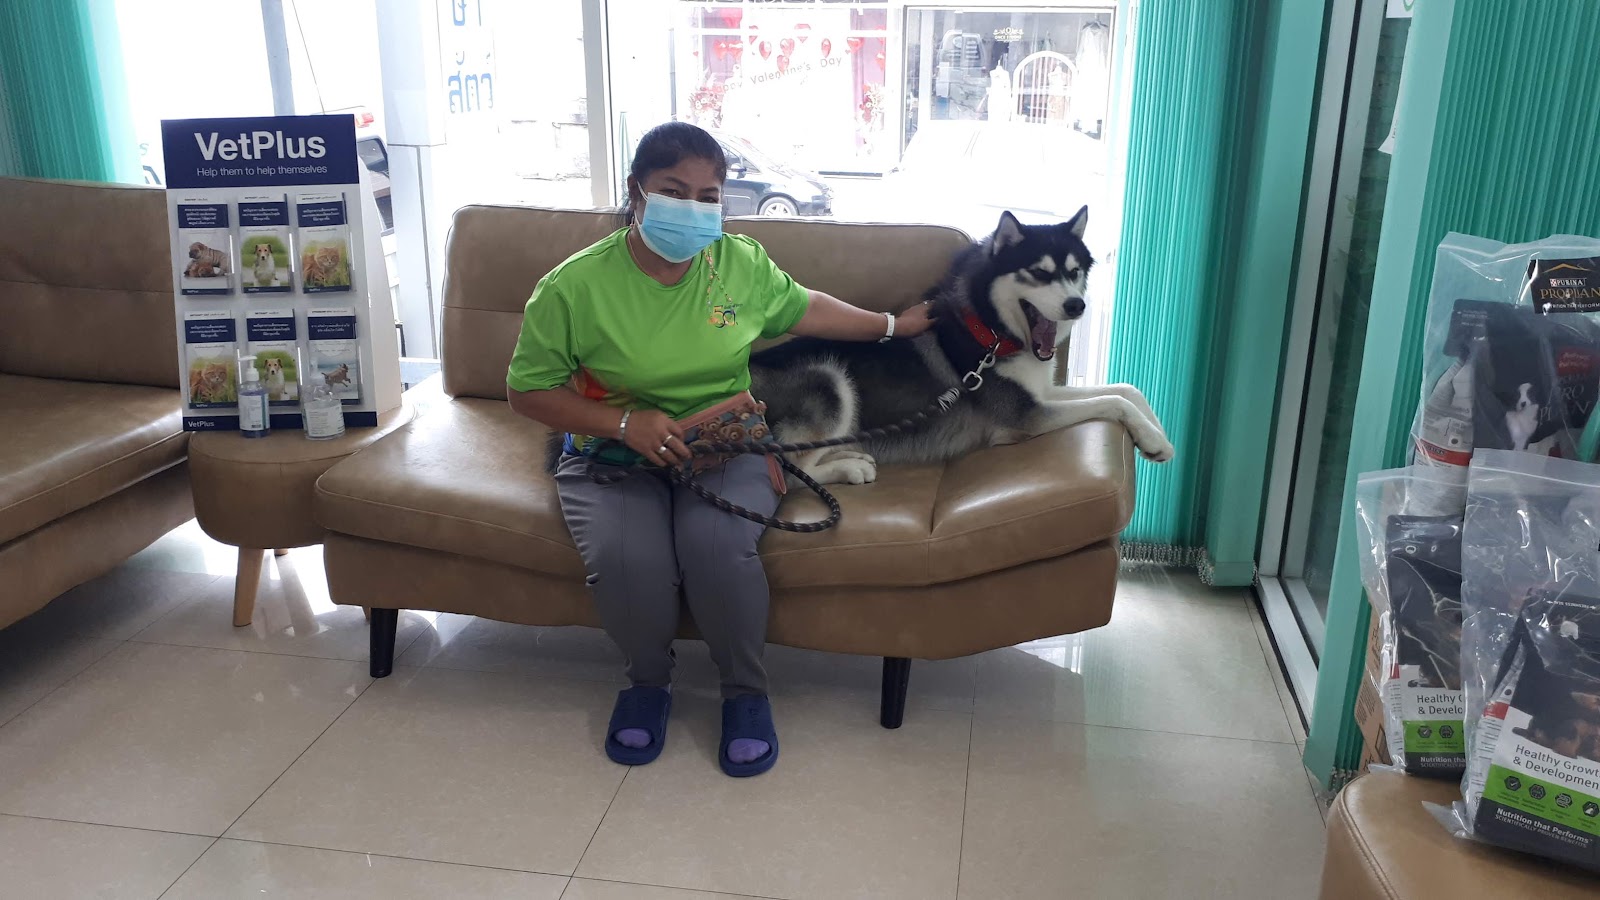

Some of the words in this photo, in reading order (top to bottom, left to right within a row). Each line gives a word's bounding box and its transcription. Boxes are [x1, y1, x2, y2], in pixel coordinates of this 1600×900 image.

[820, 57, 842, 68] Day
[193, 130, 327, 161] VetPlus
[196, 168, 218, 178] Help
[219, 167, 243, 176] them
[245, 167, 255, 175] to
[256, 166, 276, 176] help
[278, 165, 328, 175] themselves
[188, 420, 215, 428] VetPlus
[1416, 694, 1456, 704] Healthy
[1418, 706, 1426, 714] &
[1513, 756, 1522, 766] &
[1515, 744, 1561, 767] Healthy
[1563, 760, 1600, 778] Growt
[1496, 807, 1532, 825] Nutrition
[1533, 820, 1551, 831] that
[1495, 814, 1537, 832] SCIENTIFICALLY
[1537, 828, 1560, 839] PROVEN
